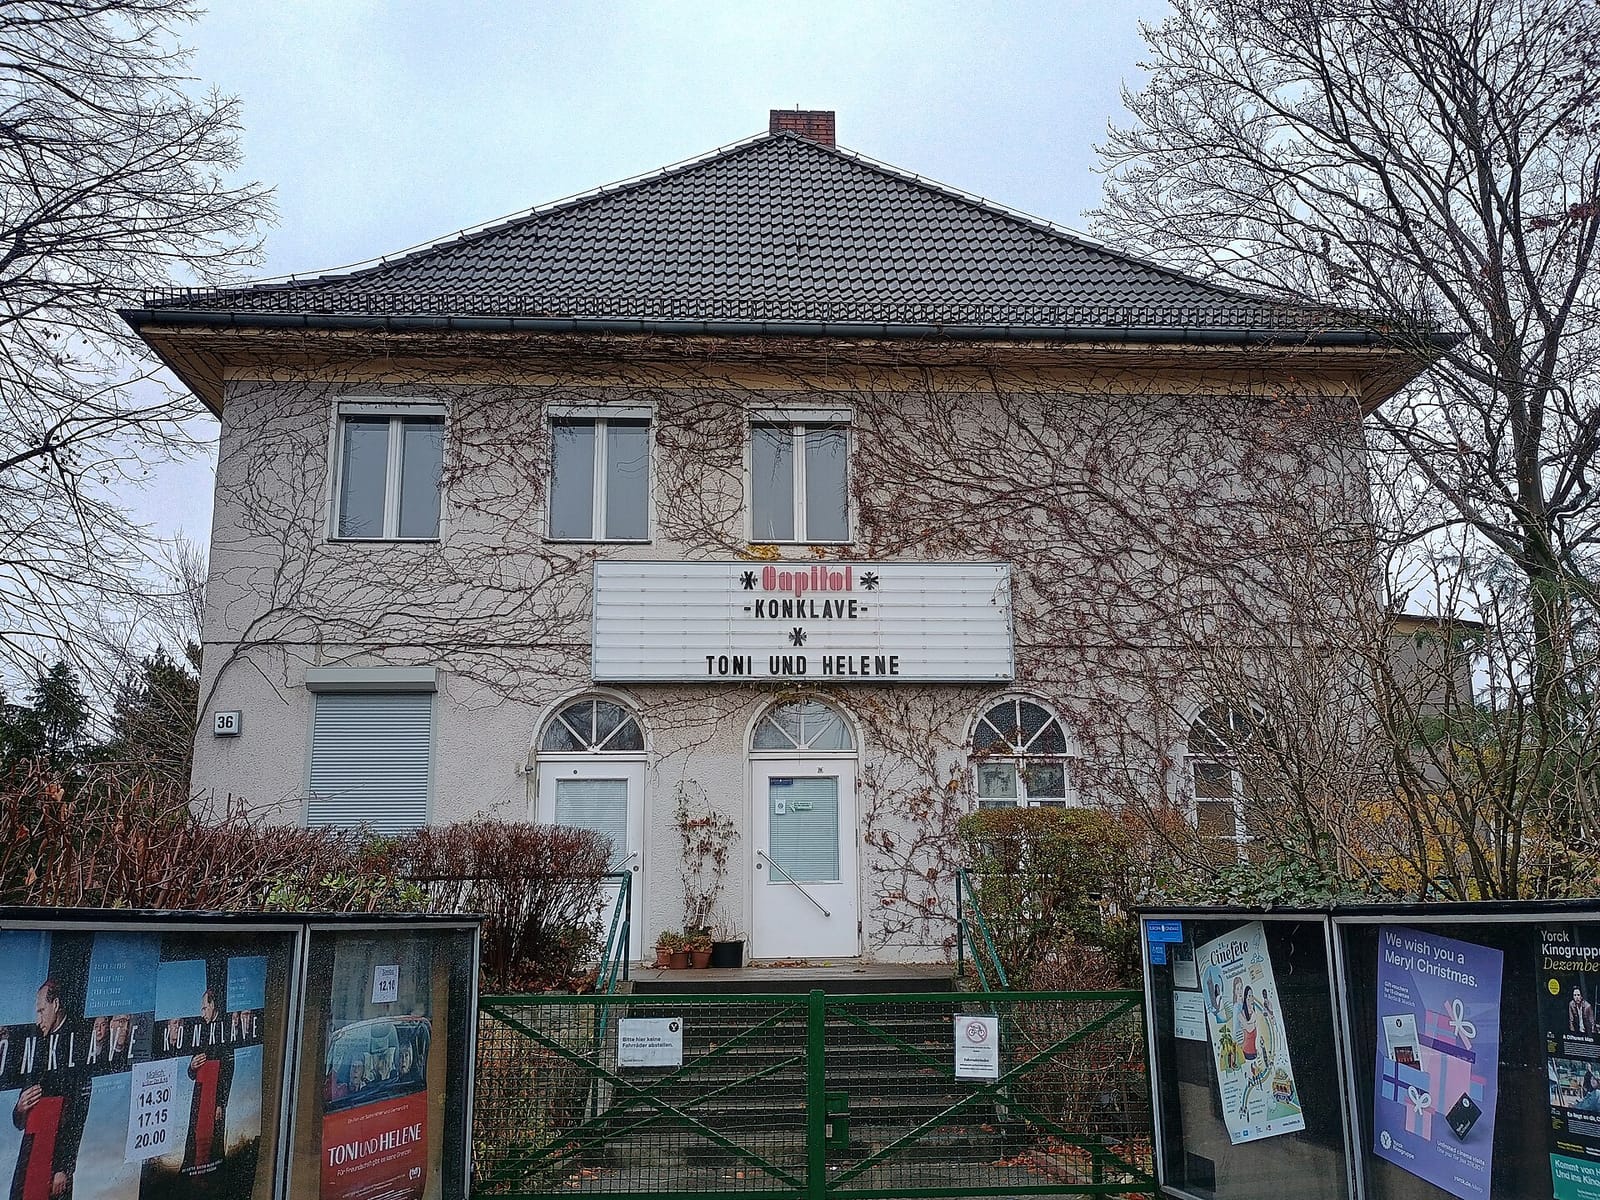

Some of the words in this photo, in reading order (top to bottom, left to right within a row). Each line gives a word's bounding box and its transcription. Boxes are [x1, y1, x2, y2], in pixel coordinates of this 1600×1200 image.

[762, 566, 852, 597] Capitol
[706, 655, 752, 675] TONI
[769, 655, 807, 675] UND
[823, 655, 899, 675] HELENE
[217, 715, 233, 729] 36
[1541, 930, 1569, 942] Yorck
[1210, 940, 1249, 966] Cinéfête
[1386, 932, 1402, 948] We
[1405, 939, 1431, 956] wish
[1433, 946, 1454, 962] you
[1457, 953, 1465, 965] a
[1541, 943, 1600, 959] Kinogrupp
[1385, 949, 1414, 971] Meryl
[1417, 958, 1478, 987] Christmas.
[164, 1016, 258, 1051] KONKLAVE
[138, 1109, 168, 1128] 17.15
[135, 1129, 166, 1149] 20.00
[328, 1141, 358, 1167] TONI
[359, 1138, 378, 1158] UND
[380, 1123, 422, 1151] HELENE
[1555, 1159, 1579, 1173] Kommt
